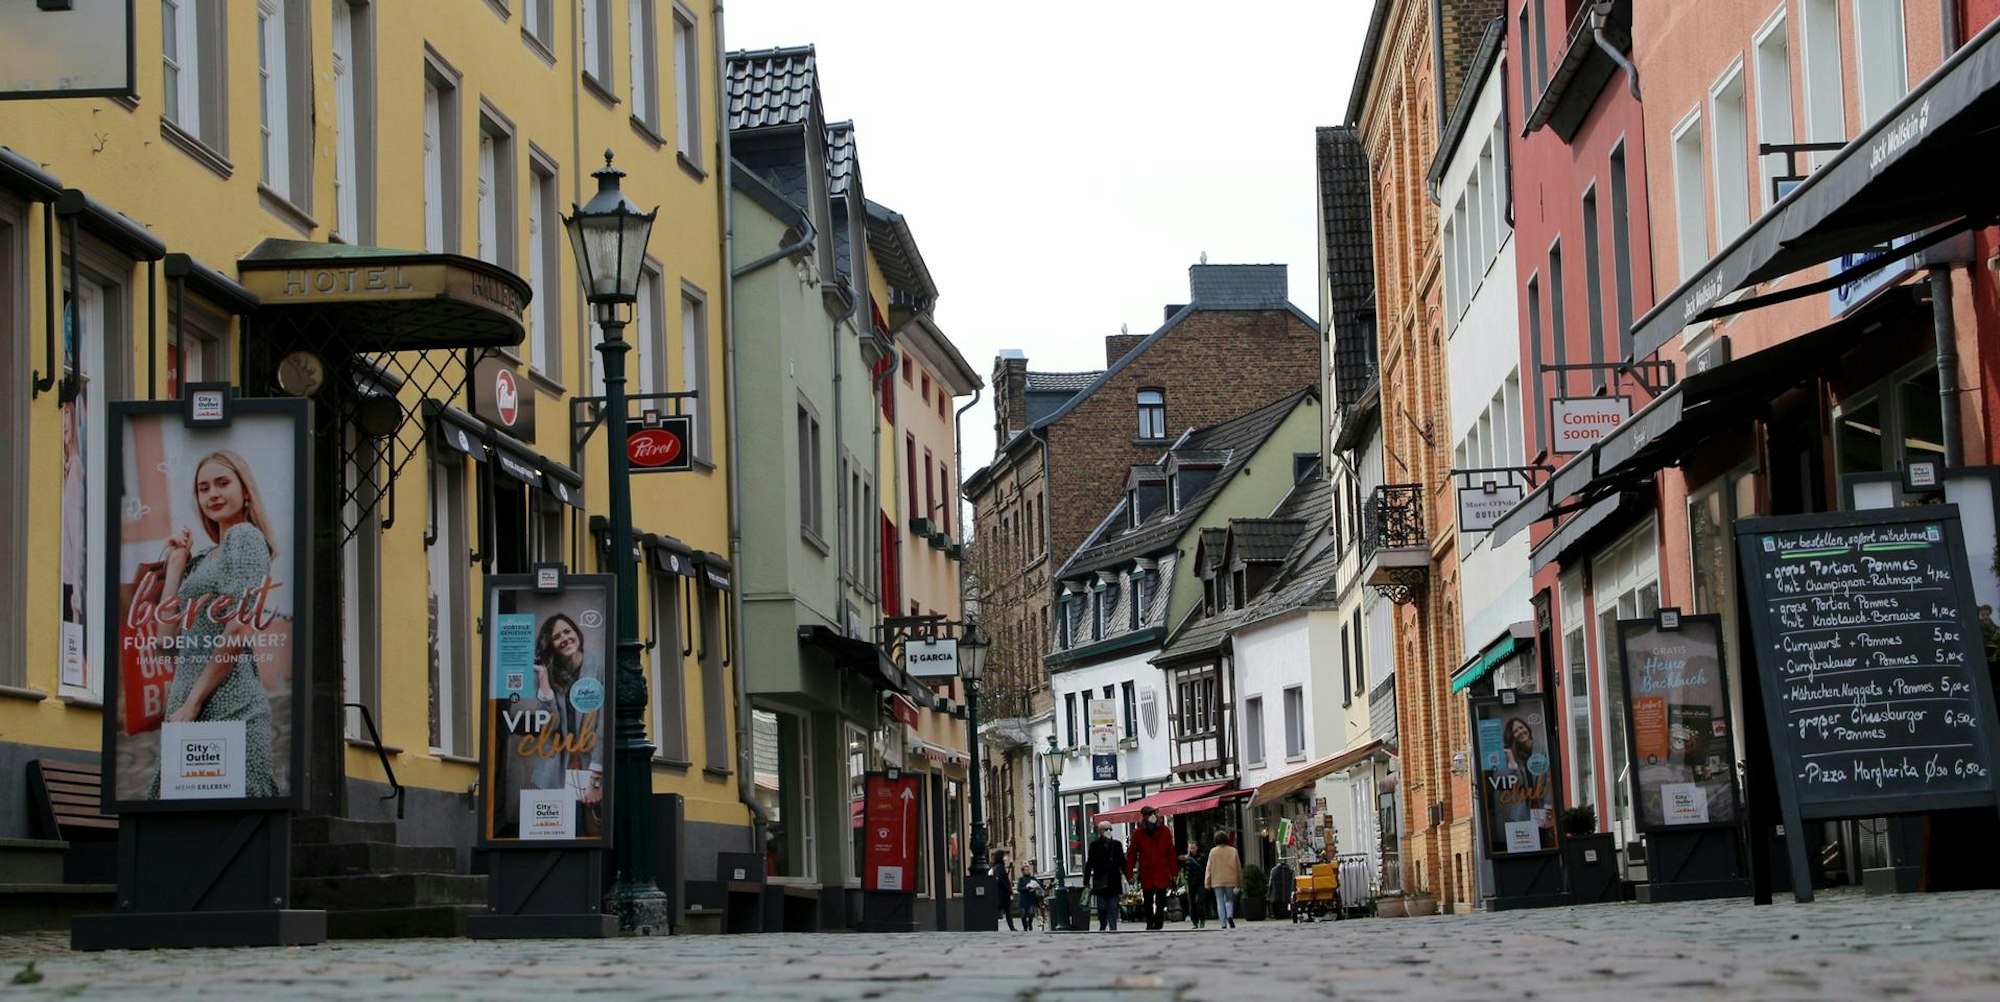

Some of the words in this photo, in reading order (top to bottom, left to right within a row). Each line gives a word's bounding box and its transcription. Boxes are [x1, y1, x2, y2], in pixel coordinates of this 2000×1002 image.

[1869, 141, 1887, 170] Jack
[1887, 113, 1919, 153] Wolfskin
[284, 266, 413, 296] HOTEL
[1684, 297, 1697, 319] Jack
[1563, 412, 1621, 426] Coming
[1563, 429, 1604, 439] soon.
[630, 437, 674, 458] Petrol
[1465, 501, 1487, 509] Marc
[1778, 537, 1796, 549] hier
[1848, 528, 1876, 550] sofort
[1810, 560, 1858, 576] Portion
[1861, 556, 1918, 572] Pommes
[1784, 576, 1801, 593] mit
[127, 571, 283, 631] bereit
[1811, 597, 1850, 612] Portion
[1854, 595, 1899, 608] Pommes
[1787, 613, 1804, 628] mit
[124, 633, 157, 650] FÜR
[163, 635, 198, 649] DEN
[203, 633, 287, 648] SOMMER?
[1783, 632, 1841, 657] Currywurst
[1857, 633, 1903, 648] Pommes
[137, 655, 171, 665] IMMER
[214, 652, 274, 664] GÜNSTIGER
[920, 653, 953, 662] GARCIA
[1652, 645, 1687, 656] GRATIS
[1786, 655, 1857, 683] Currykrakauer
[1873, 652, 1919, 667] Pommes
[1893, 678, 1935, 694] Pommes
[502, 710, 553, 733] VIP
[518, 710, 599, 759] club
[1833, 727, 1886, 741] Pommes
[186, 744, 209, 754] City
[186, 753, 220, 762] Outlet
[1854, 757, 1919, 788] Margherita
[1488, 775, 1518, 790] VIP
[1501, 772, 1546, 805] club
